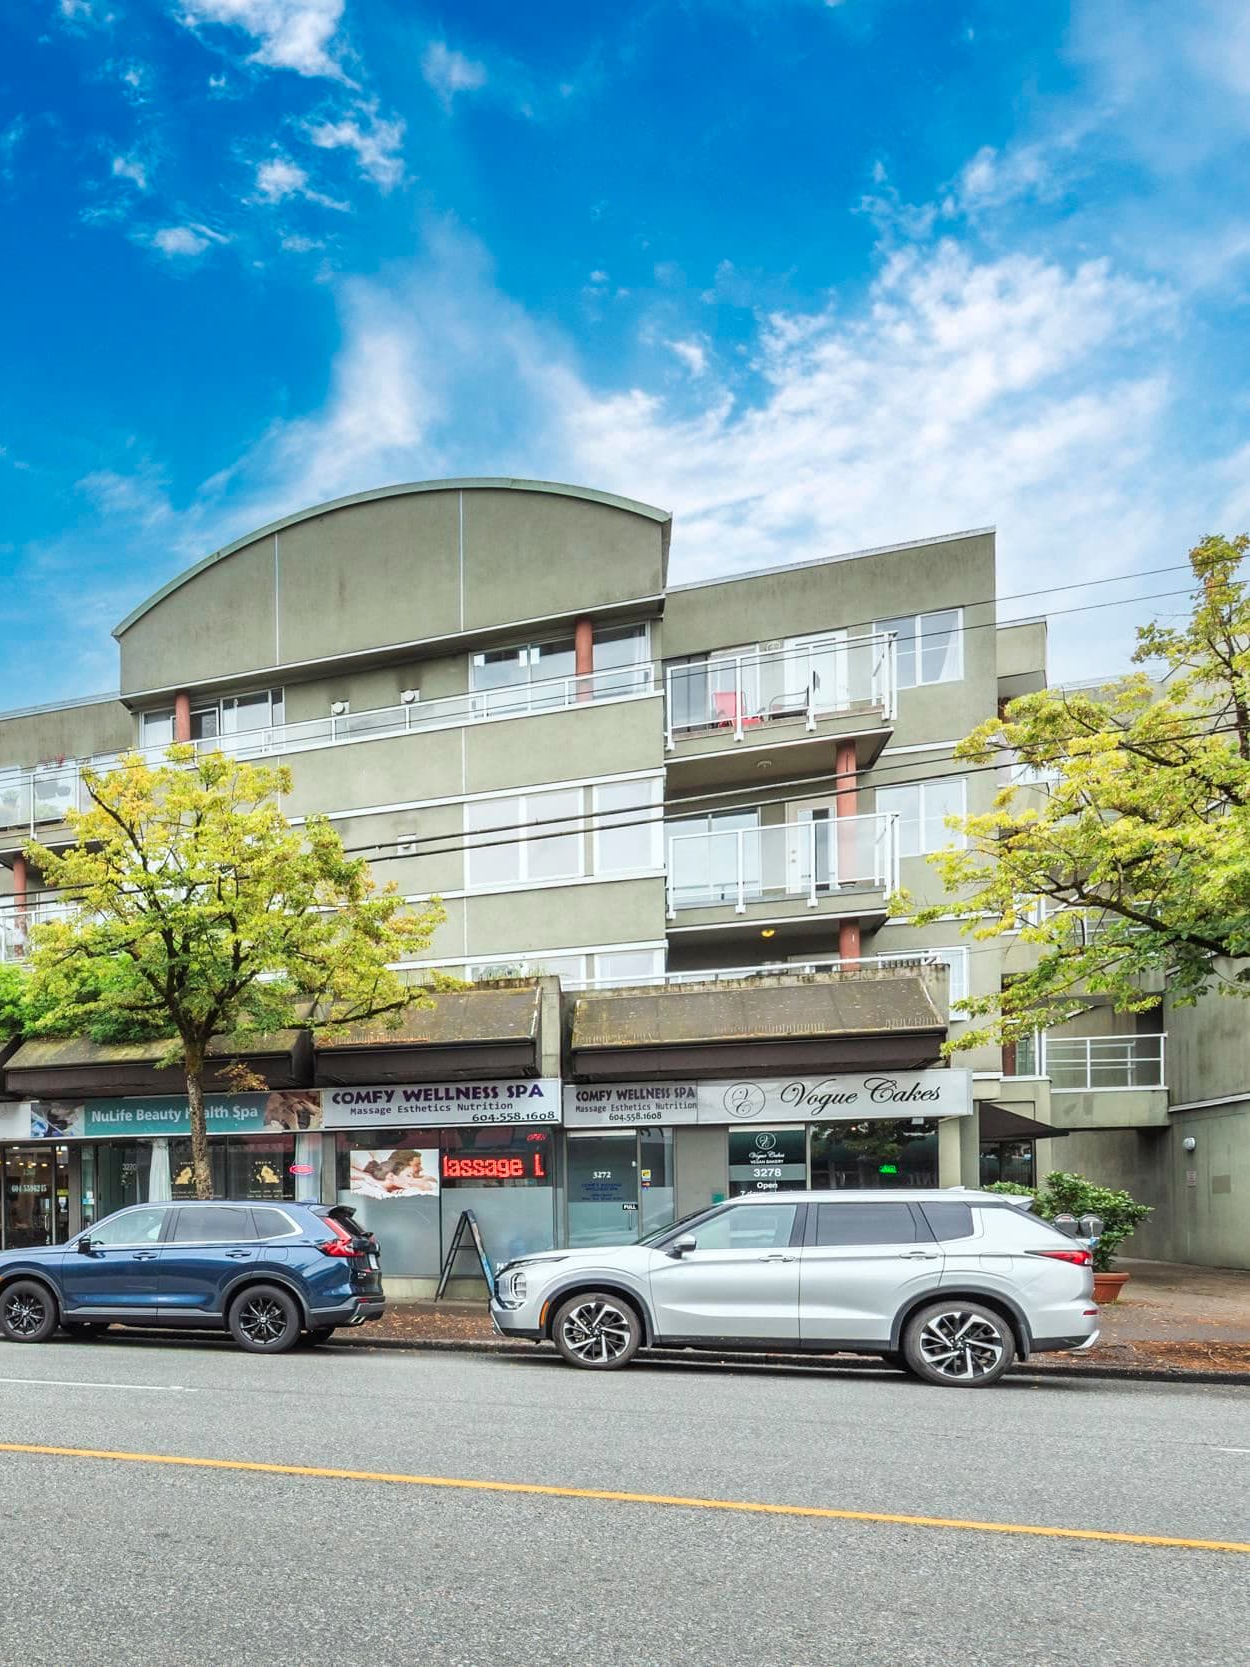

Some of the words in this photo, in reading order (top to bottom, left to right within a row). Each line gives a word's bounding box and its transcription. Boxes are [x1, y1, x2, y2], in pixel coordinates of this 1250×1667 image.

[332, 1090, 395, 1105] COMFY
[402, 1086, 499, 1102] WELLNESS
[506, 1084, 544, 1098] SPA
[576, 1090, 612, 1102] COMFY
[616, 1087, 670, 1100] WELLNESS
[675, 1086, 696, 1098] SPA
[780, 1079, 858, 1116] Vogue
[863, 1077, 941, 1103] Cakes
[350, 1107, 392, 1116] Massage
[397, 1103, 451, 1113] Esthetics
[457, 1102, 513, 1111] Nutrition
[575, 1105, 607, 1114] Massage
[610, 1103, 651, 1112] Esthetics
[655, 1101, 698, 1110] Nutrition
[91, 1110, 133, 1122] NuLife
[136, 1109, 182, 1123] Beauty
[185, 1106, 229, 1120] Halth
[232, 1106, 258, 1121] Spa
[472, 1110, 556, 1122] 604.558.1608
[608, 1112, 662, 1122] 604.558.1608
[592, 1171, 611, 1179] 3272
[753, 1168, 782, 1178] 3278
[756, 1181, 778, 1190] Open
